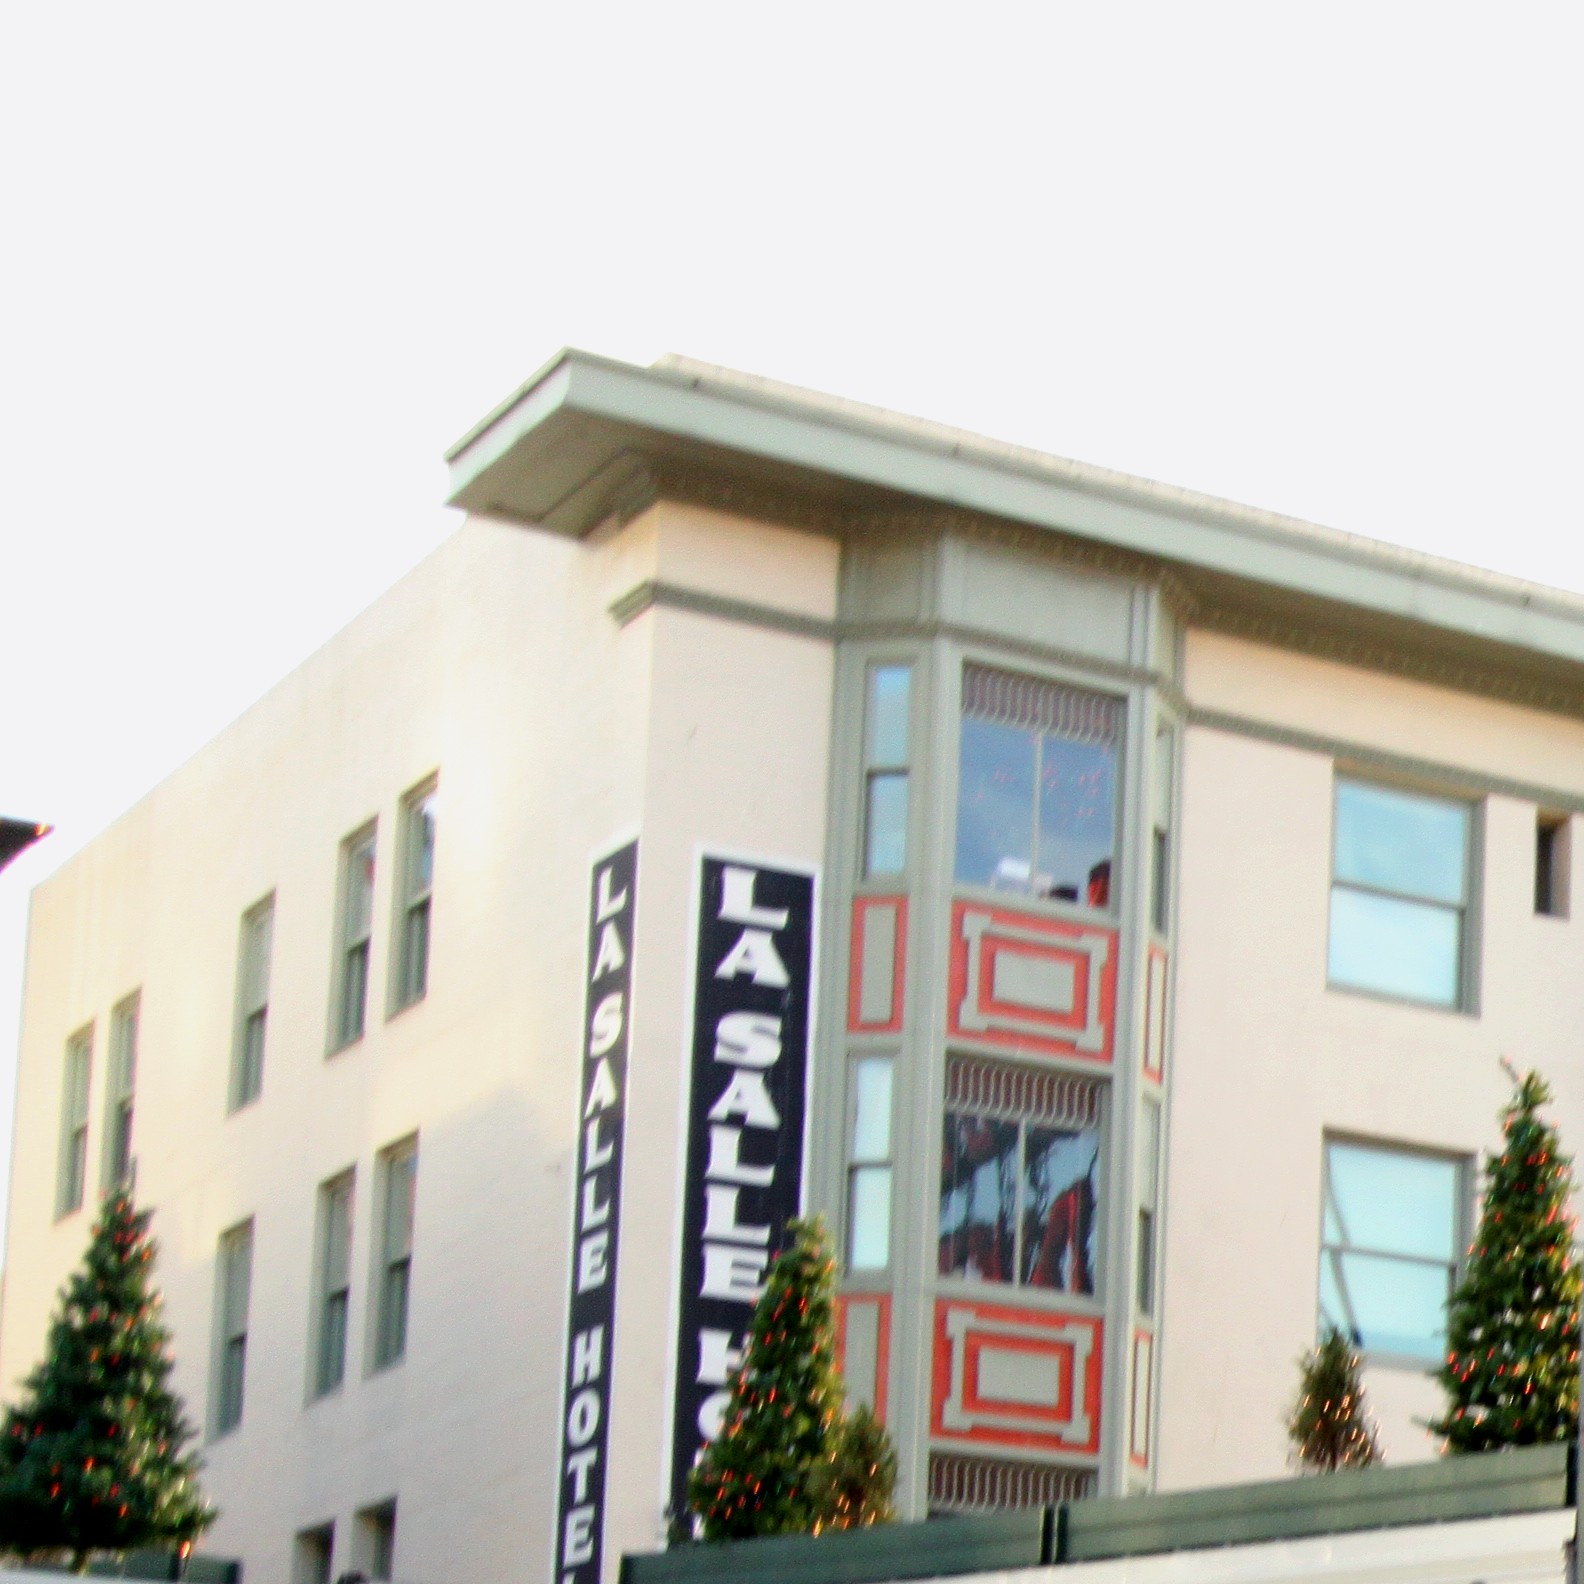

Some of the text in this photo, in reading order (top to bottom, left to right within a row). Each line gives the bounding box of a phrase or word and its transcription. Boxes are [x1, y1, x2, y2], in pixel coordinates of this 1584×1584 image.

[595, 865, 628, 985] LA
[714, 865, 791, 989] LA
[579, 992, 624, 1293] SALLE
[701, 1011, 781, 1302] SALLE
